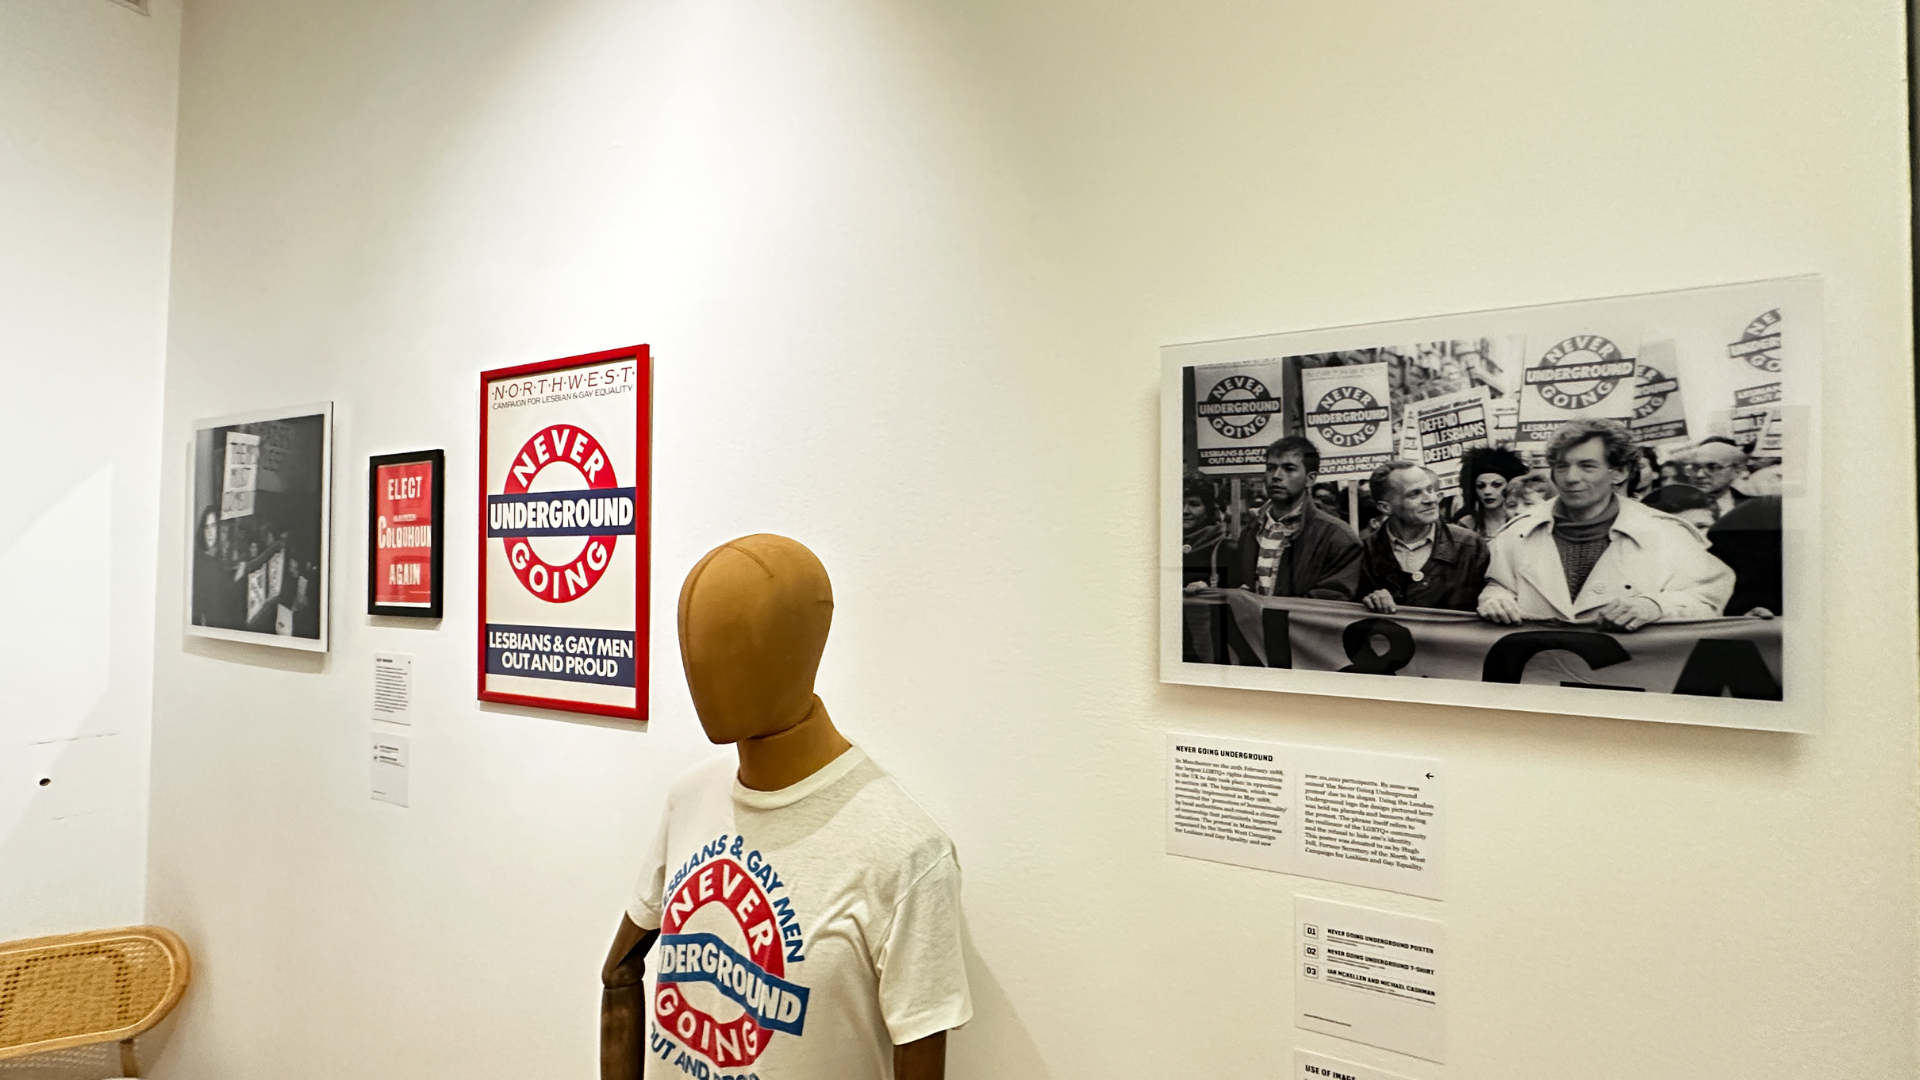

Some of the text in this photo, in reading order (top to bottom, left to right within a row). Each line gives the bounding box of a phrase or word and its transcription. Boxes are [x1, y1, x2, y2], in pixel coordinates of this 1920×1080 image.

[1546, 336, 1614, 364] NEVER
[1527, 362, 1633, 382] UNDERGROUND
[492, 400, 526, 410] CAMPAIGN
[527, 398, 541, 406] FOR
[542, 394, 572, 404] LESBIAN
[578, 390, 594, 398] GAY
[594, 385, 633, 396] EQUALITY
[1212, 378, 1264, 398] NEVER
[1321, 388, 1372, 409] NEVER
[1542, 380, 1613, 408] GOING
[1200, 400, 1280, 414] UNDERGROUND
[1308, 409, 1387, 425] UNDERGROUND
[1213, 416, 1266, 438] GOING
[1322, 424, 1376, 446] GOING
[1420, 413, 1458, 433] DEFEND
[513, 429, 604, 488] NEVER
[388, 476, 422, 500] ELECT
[490, 497, 633, 530] UNDERGROUND
[389, 564, 420, 586] AGAIN
[512, 542, 608, 599] GOING
[489, 632, 633, 658] LESBIANS & GAY MEN
[502, 652, 618, 678] OUT AND PROUD
[1176, 745, 1273, 761] NEVER GOING UNDERGROUND
[670, 864, 774, 955] NEVER
[730, 835, 744, 861] &
[747, 850, 784, 894] GAY
[773, 896, 805, 963] MEN
[1307, 947, 1316, 955] 02
[1346, 932, 1364, 940] GOING
[1365, 936, 1409, 949] UNDERGROUND
[1410, 944, 1434, 954] POSTER
[1346, 952, 1364, 960] GOING
[1365, 956, 1409, 969] UNDERGROUND
[1410, 965, 1434, 975] T-SHIRT
[660, 942, 802, 1023] DERGROUND
[1338, 971, 1366, 981] MCKELLEN
[1380, 980, 1404, 990] MICHAEL
[1406, 985, 1435, 996] CASHMAN
[656, 988, 758, 1062] GOING
[674, 1052, 710, 1080] AND
[1305, 1064, 1319, 1074] USE
[1321, 1069, 1330, 1077] OF
